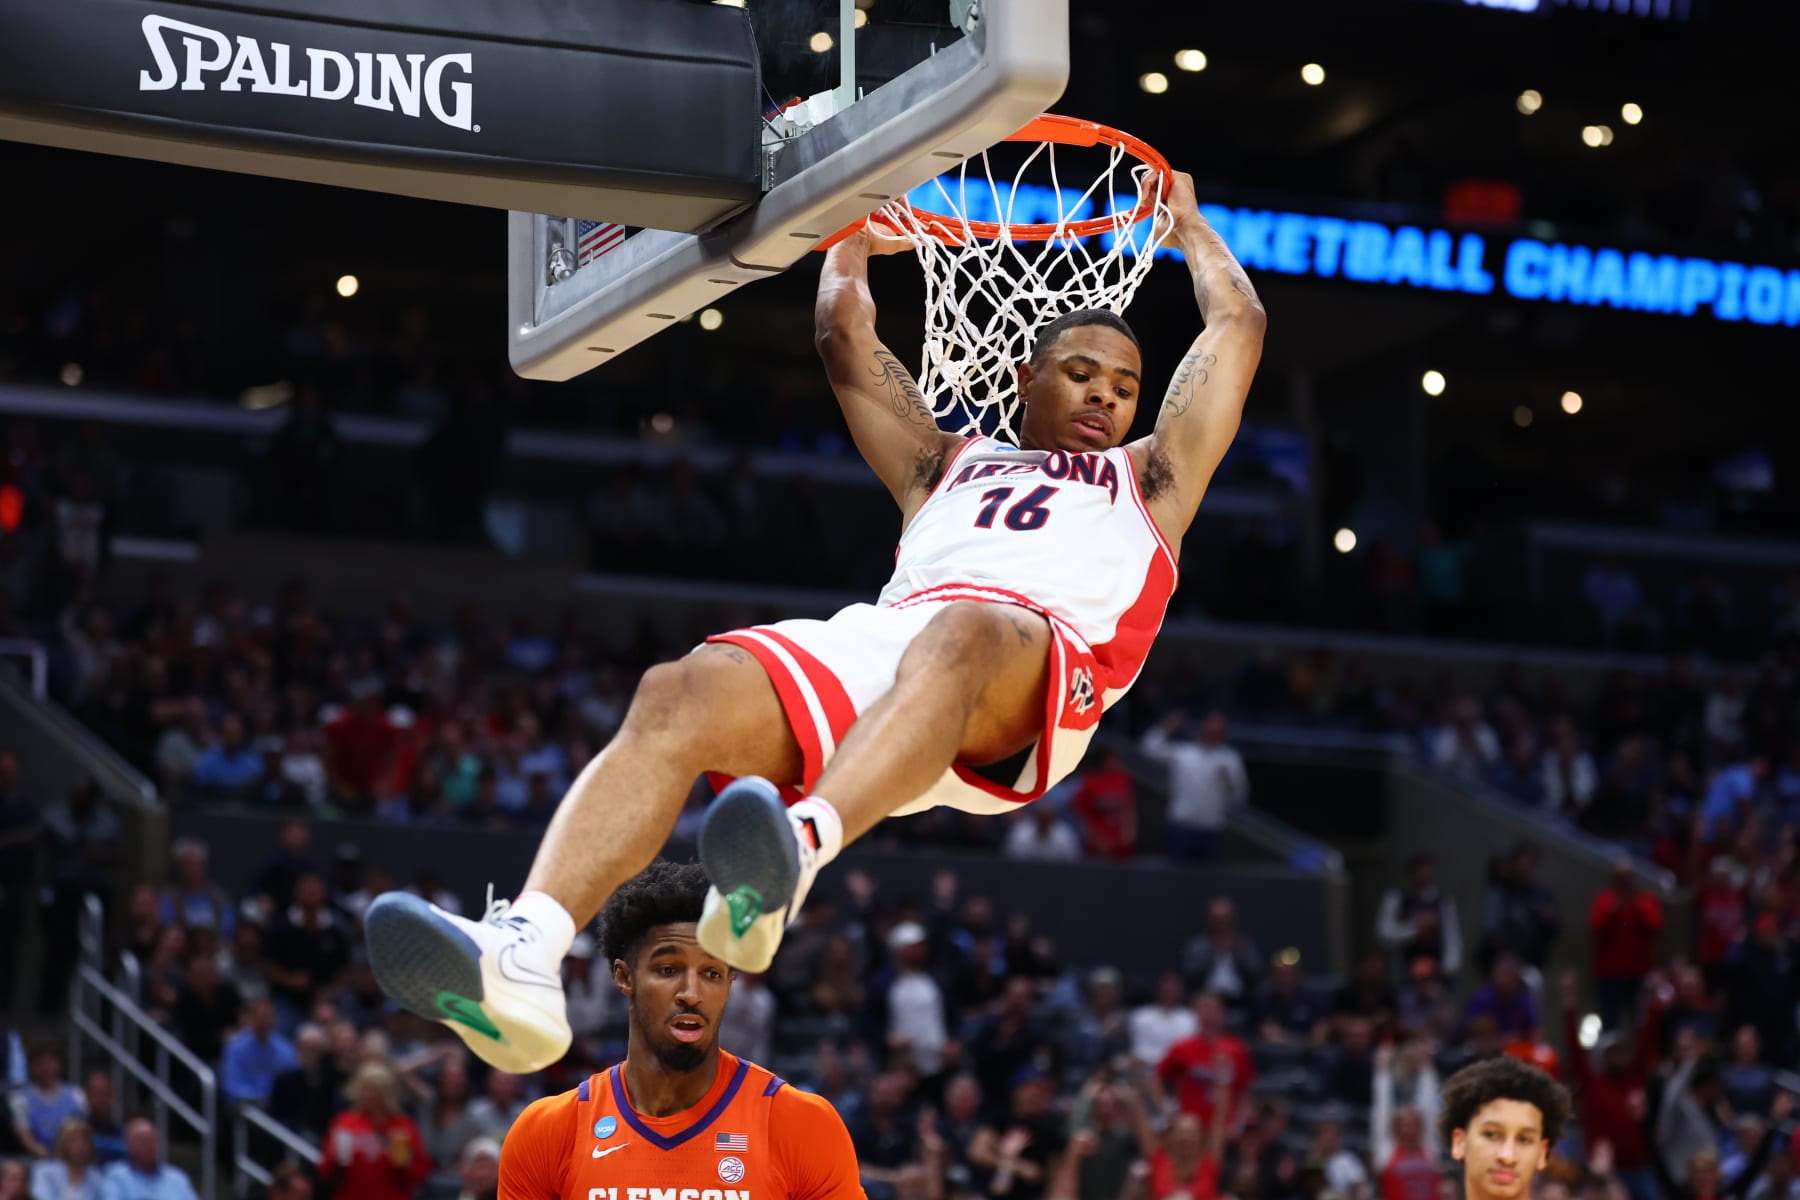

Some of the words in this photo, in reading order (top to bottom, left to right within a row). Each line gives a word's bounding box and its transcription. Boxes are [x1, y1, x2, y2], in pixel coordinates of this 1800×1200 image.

[140, 14, 473, 132] SPALDING
[973, 484, 1060, 531] 16
[721, 1165, 742, 1173] ACC
